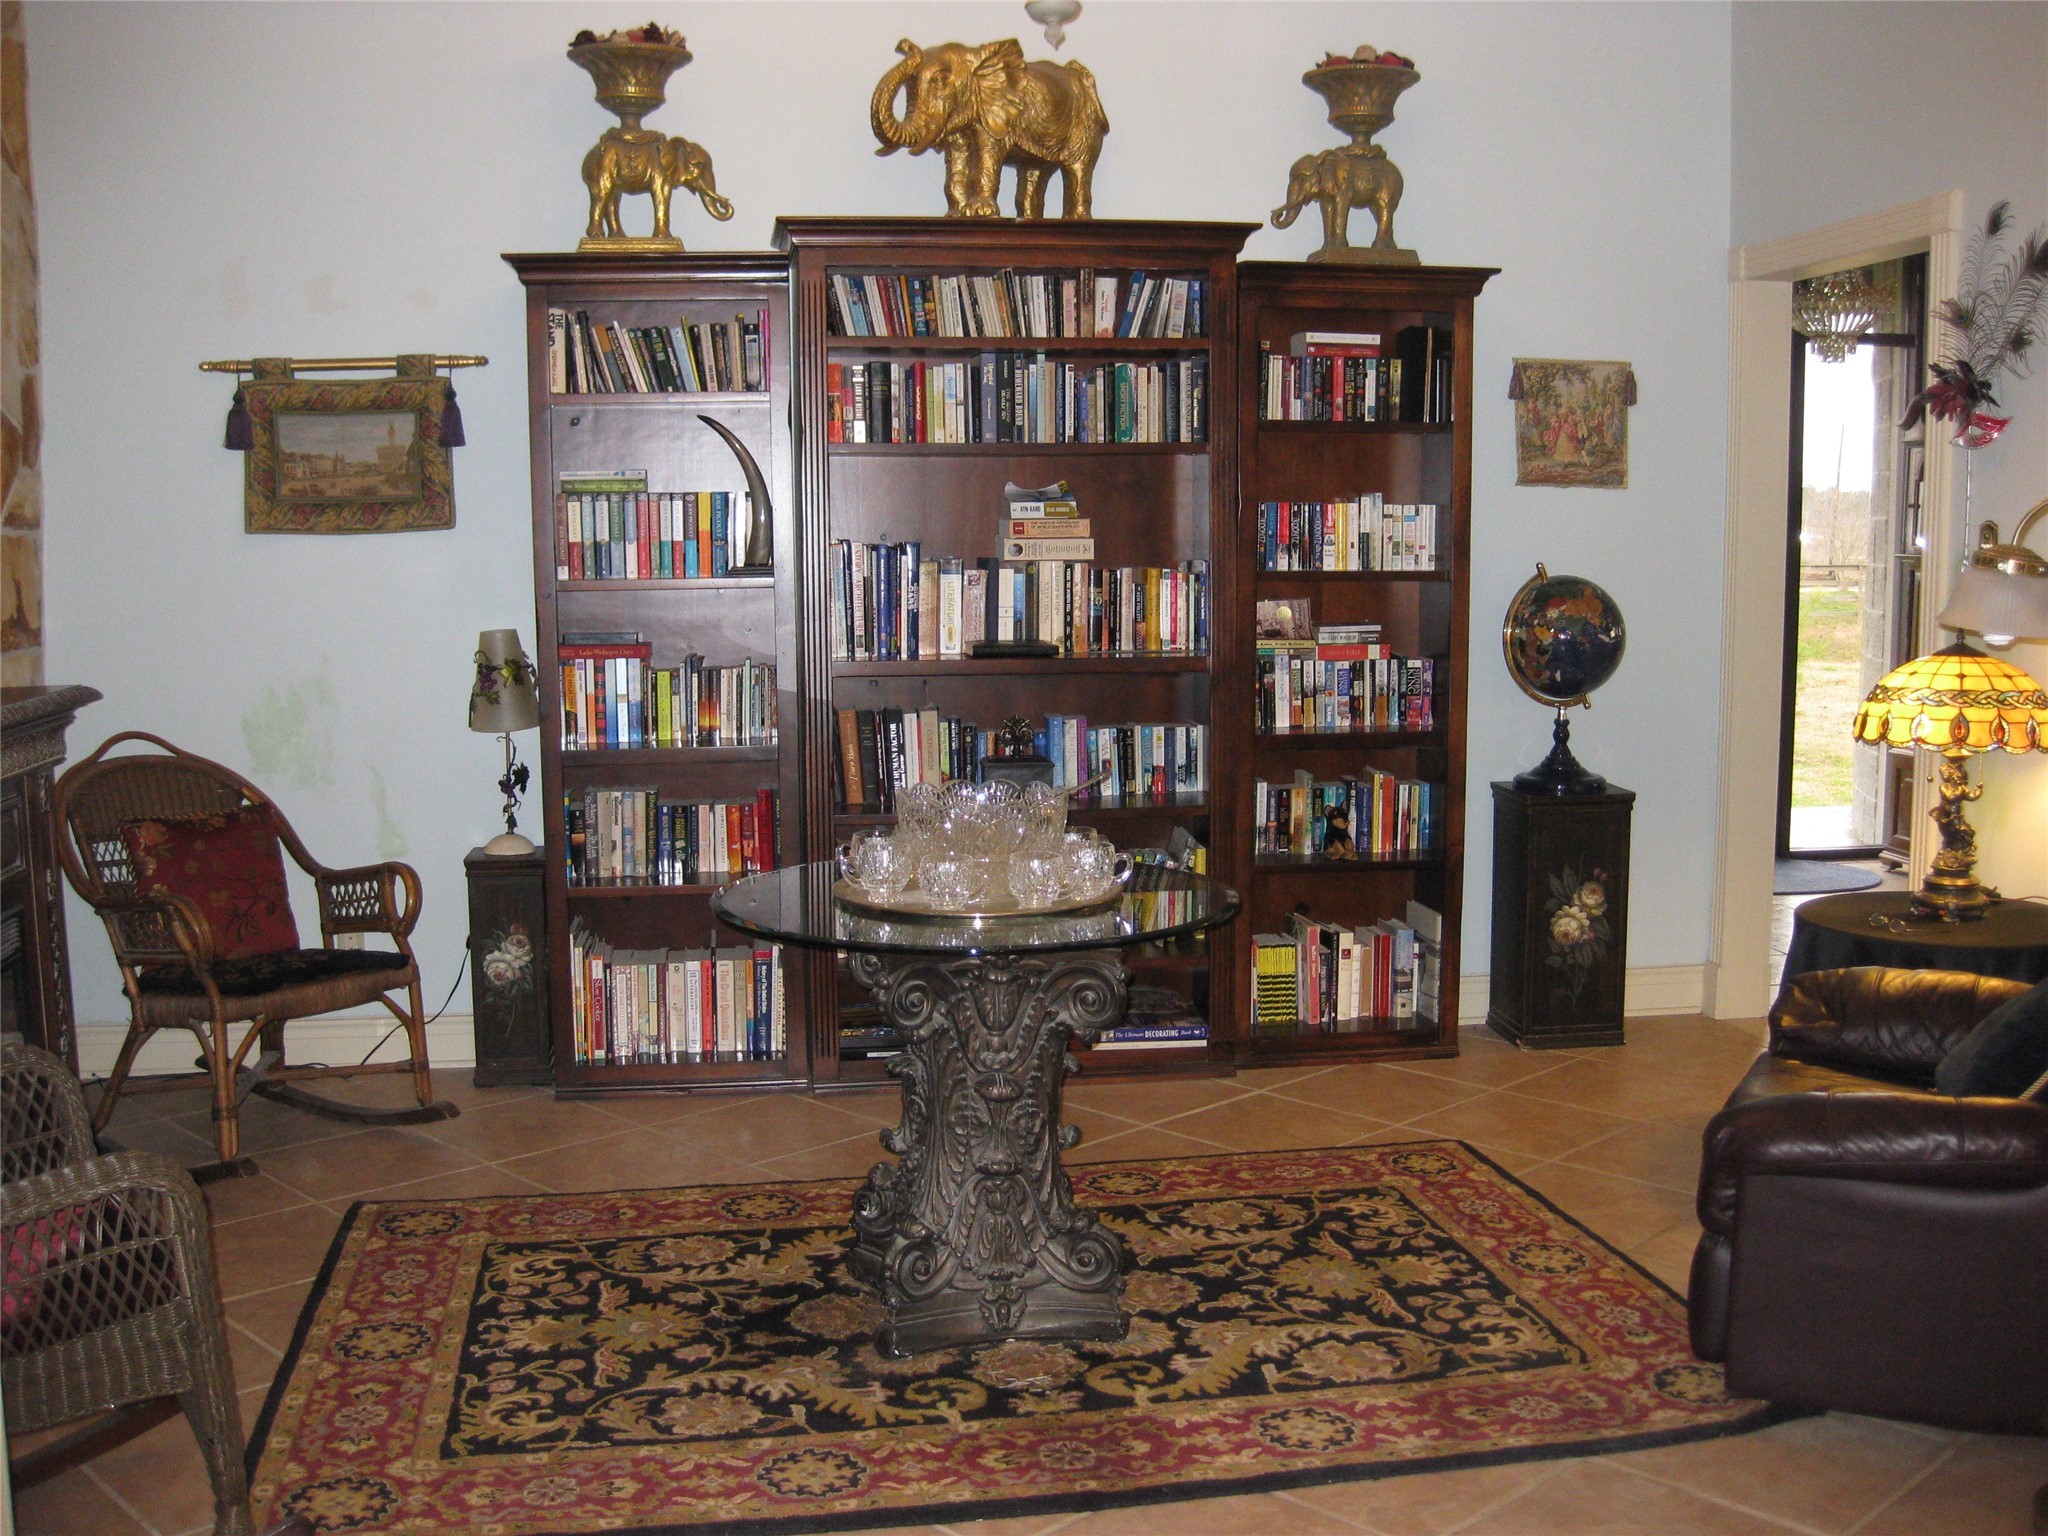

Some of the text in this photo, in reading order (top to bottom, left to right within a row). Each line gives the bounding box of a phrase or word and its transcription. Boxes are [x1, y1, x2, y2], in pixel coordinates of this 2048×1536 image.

[556, 313, 564, 330] THE
[1015, 369, 1024, 426] HOMEWARD BOUND
[1185, 389, 1192, 401] OF
[1292, 519, 1300, 544] KOONTZ
[1315, 520, 1323, 544] KOONTZ
[648, 579, 656, 592] Lake
[854, 549, 864, 634] STORY ARCHITECTURE
[1407, 669, 1416, 695] KING
[889, 723, 900, 752] FACTOR
[926, 728, 935, 771] EVERGREEN
[892, 752, 902, 778] HUMAN
[584, 795, 592, 825] Stewart
[589, 803, 598, 825] Mary
[594, 979, 603, 1022] Slow Cooker
[719, 970, 731, 1041] The Great Quotations
[1145, 1028, 1179, 1038] DECORATING
